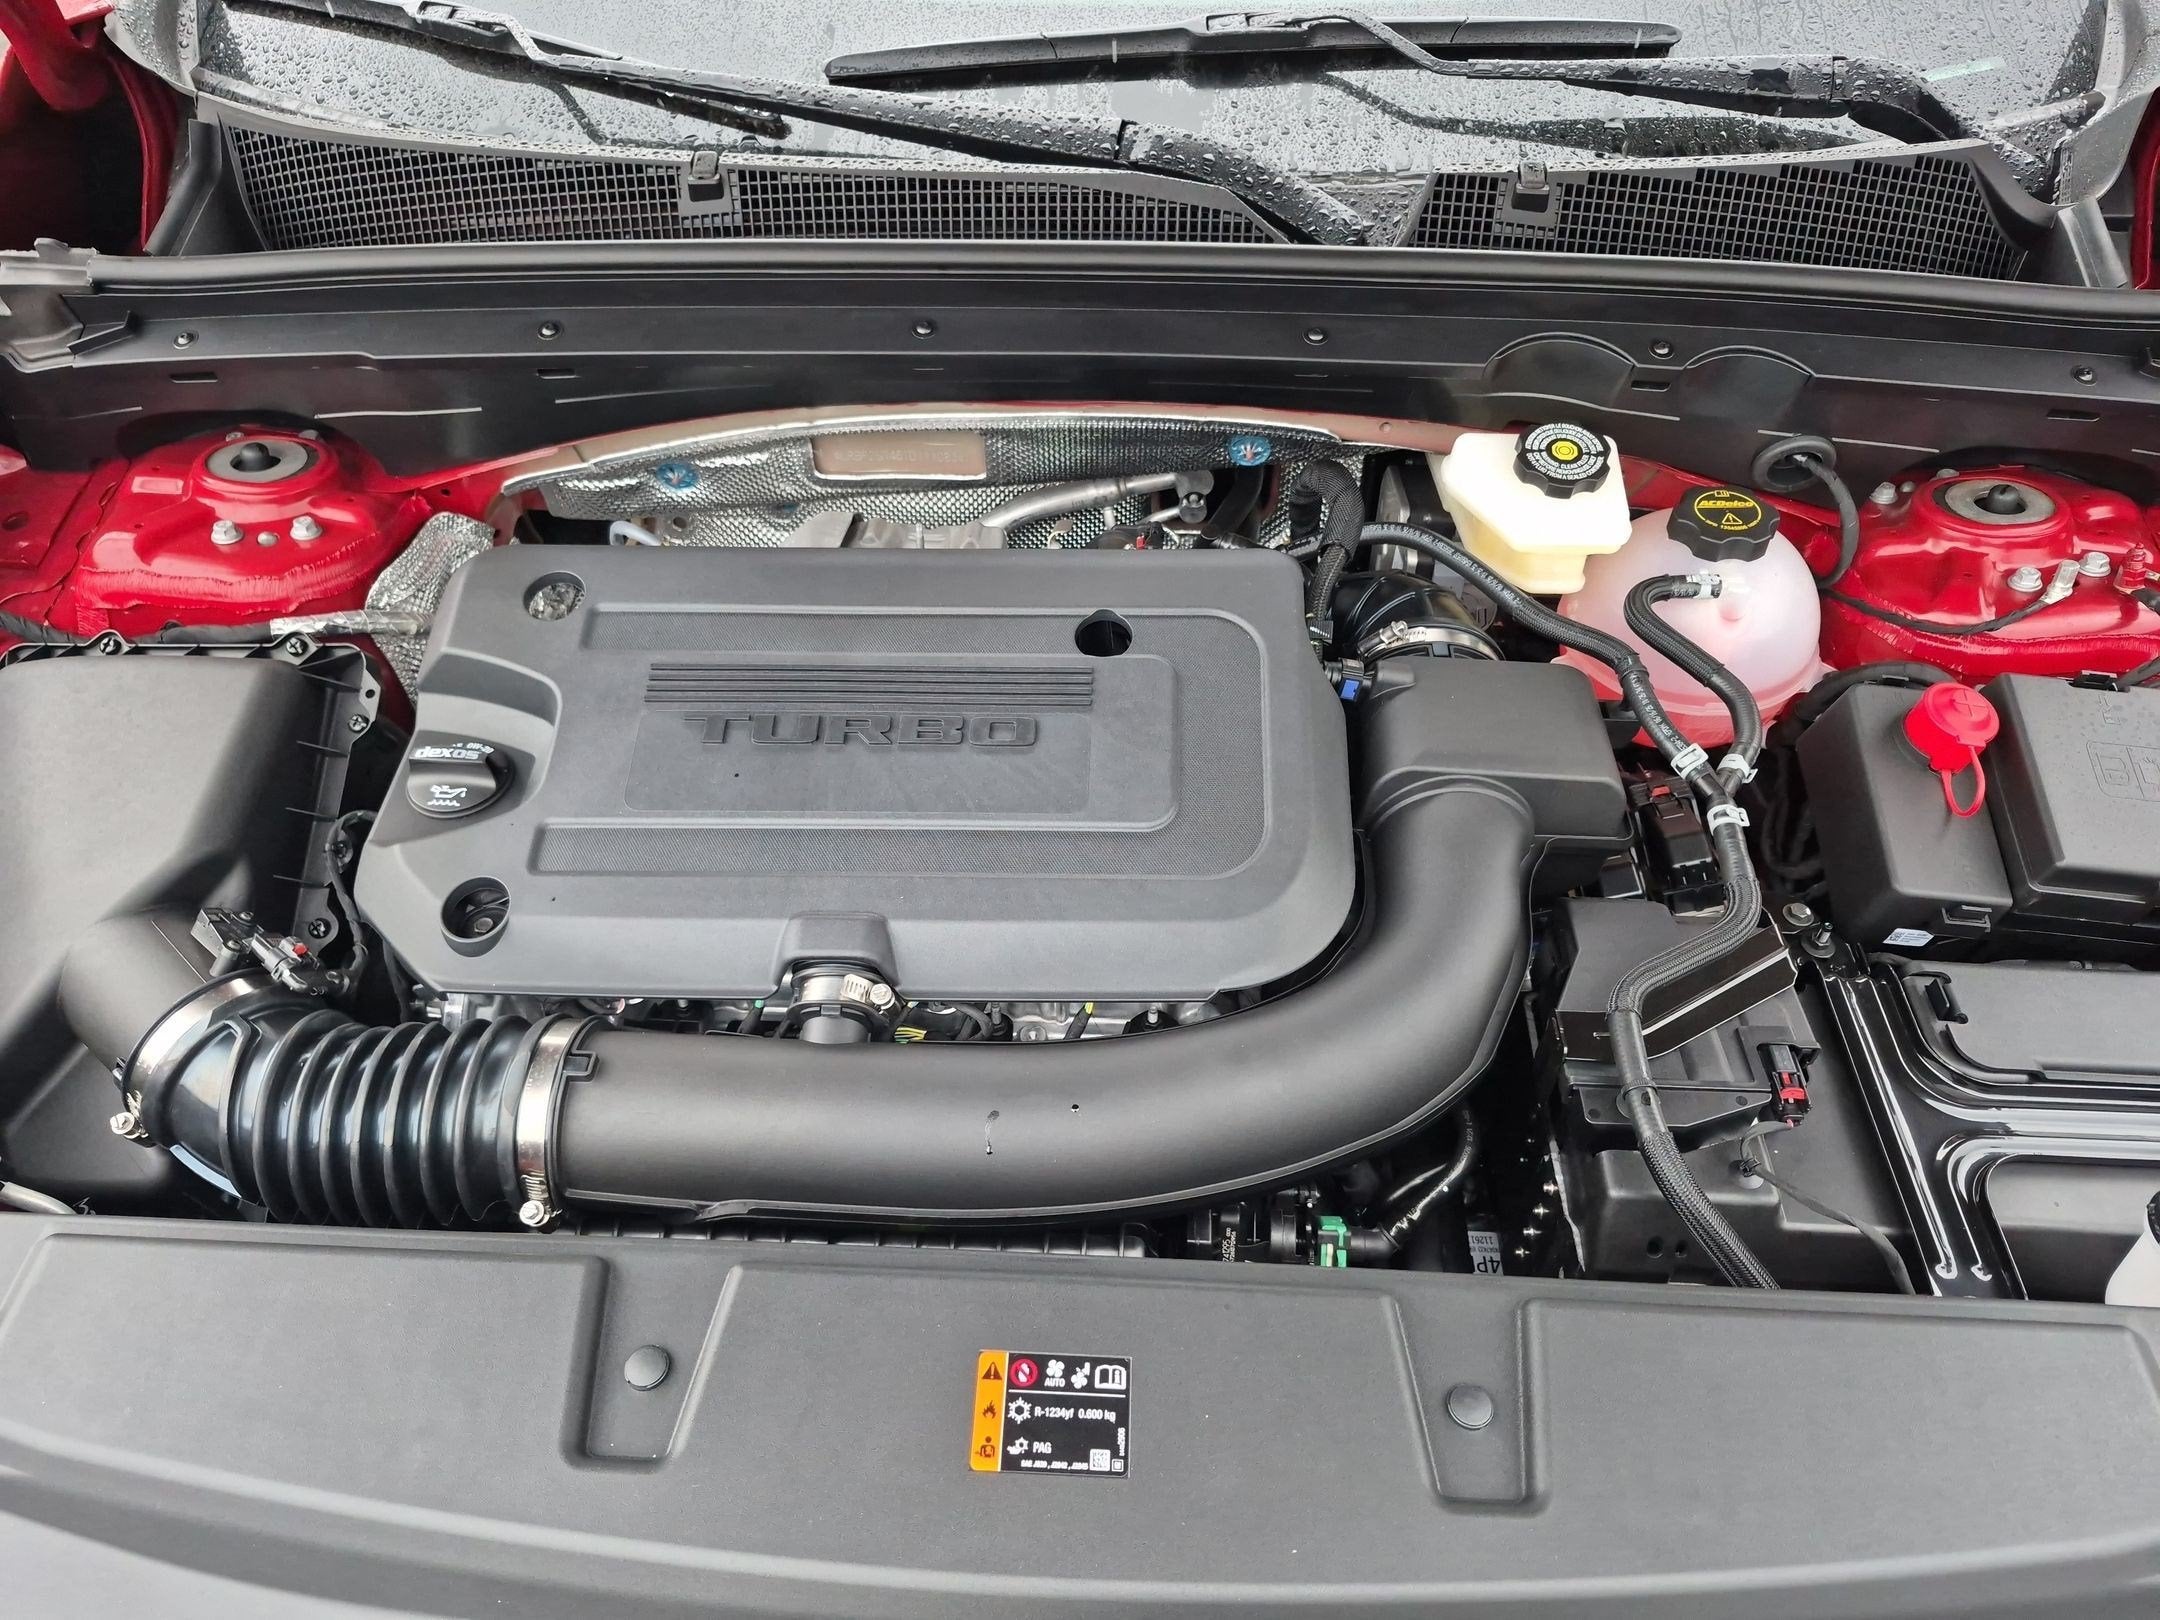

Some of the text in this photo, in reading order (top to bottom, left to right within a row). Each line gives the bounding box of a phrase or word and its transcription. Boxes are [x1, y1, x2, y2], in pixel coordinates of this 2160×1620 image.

[1698, 500, 1754, 509] ACDelco
[684, 713, 1038, 747] TURBO
[415, 745, 480, 760] dexos
[1044, 1378, 1065, 1388] AUTO
[1034, 1406, 1116, 1424] R-1234yf 0.600 kg
[1033, 1441, 1052, 1454] PAG
